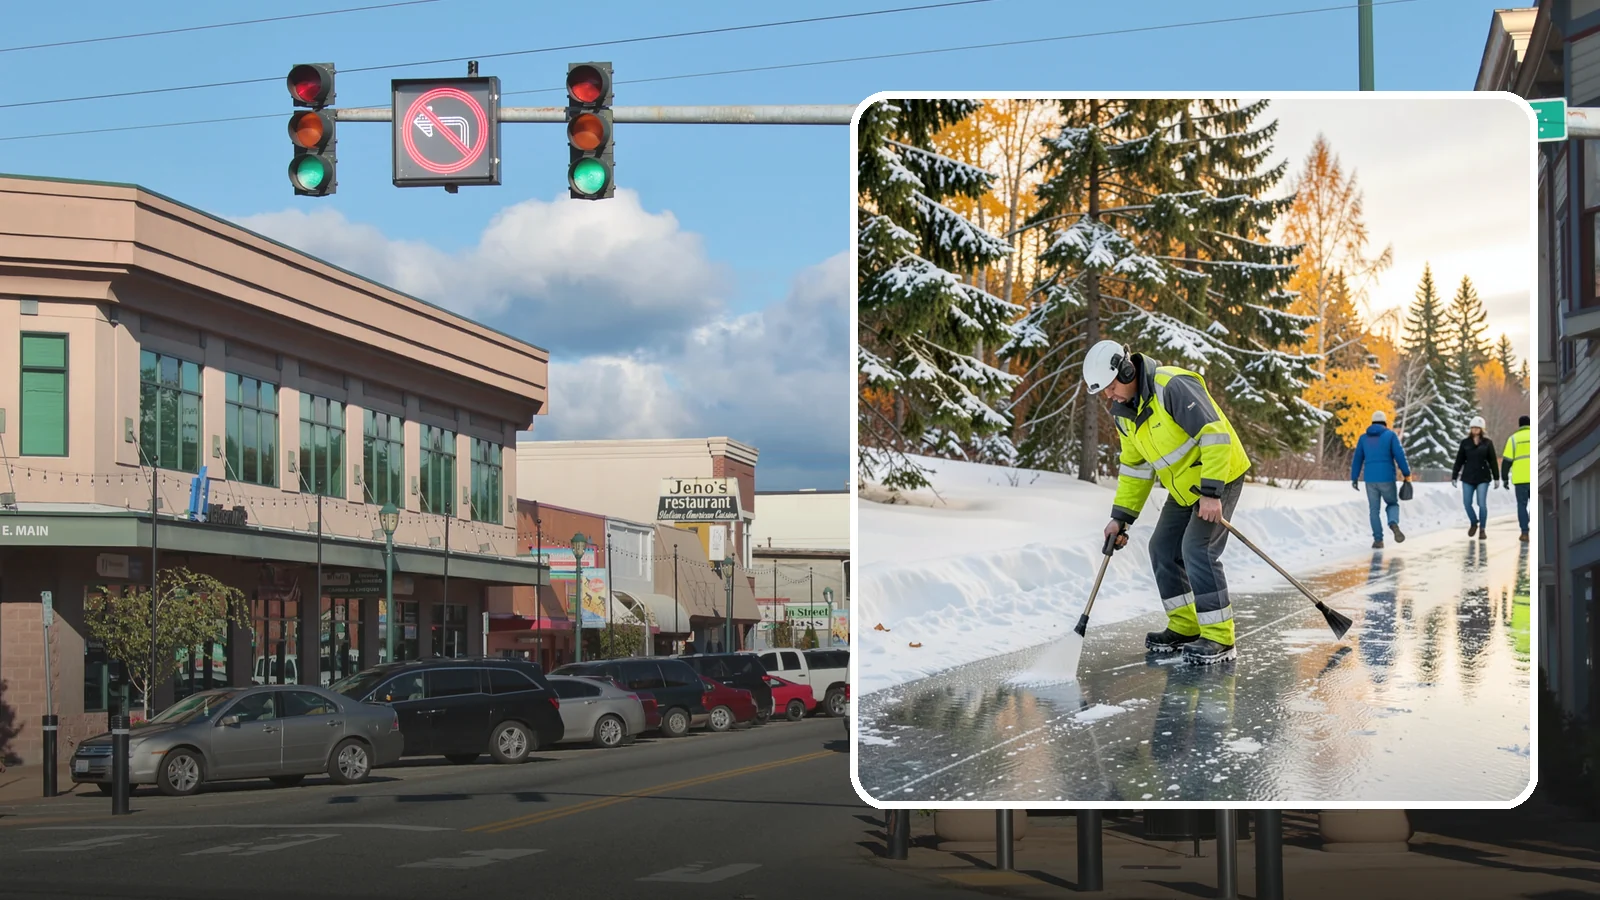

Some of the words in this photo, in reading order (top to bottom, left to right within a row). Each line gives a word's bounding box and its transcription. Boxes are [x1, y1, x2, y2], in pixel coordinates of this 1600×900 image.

[669, 480, 728, 494] Jeno's
[665, 496, 731, 509] restaurant
[686, 510, 714, 519] American
[715, 509, 737, 519] Cuisine
[2, 525, 13, 536] E.
[15, 525, 49, 536] MAIN
[797, 608, 828, 616] Street
